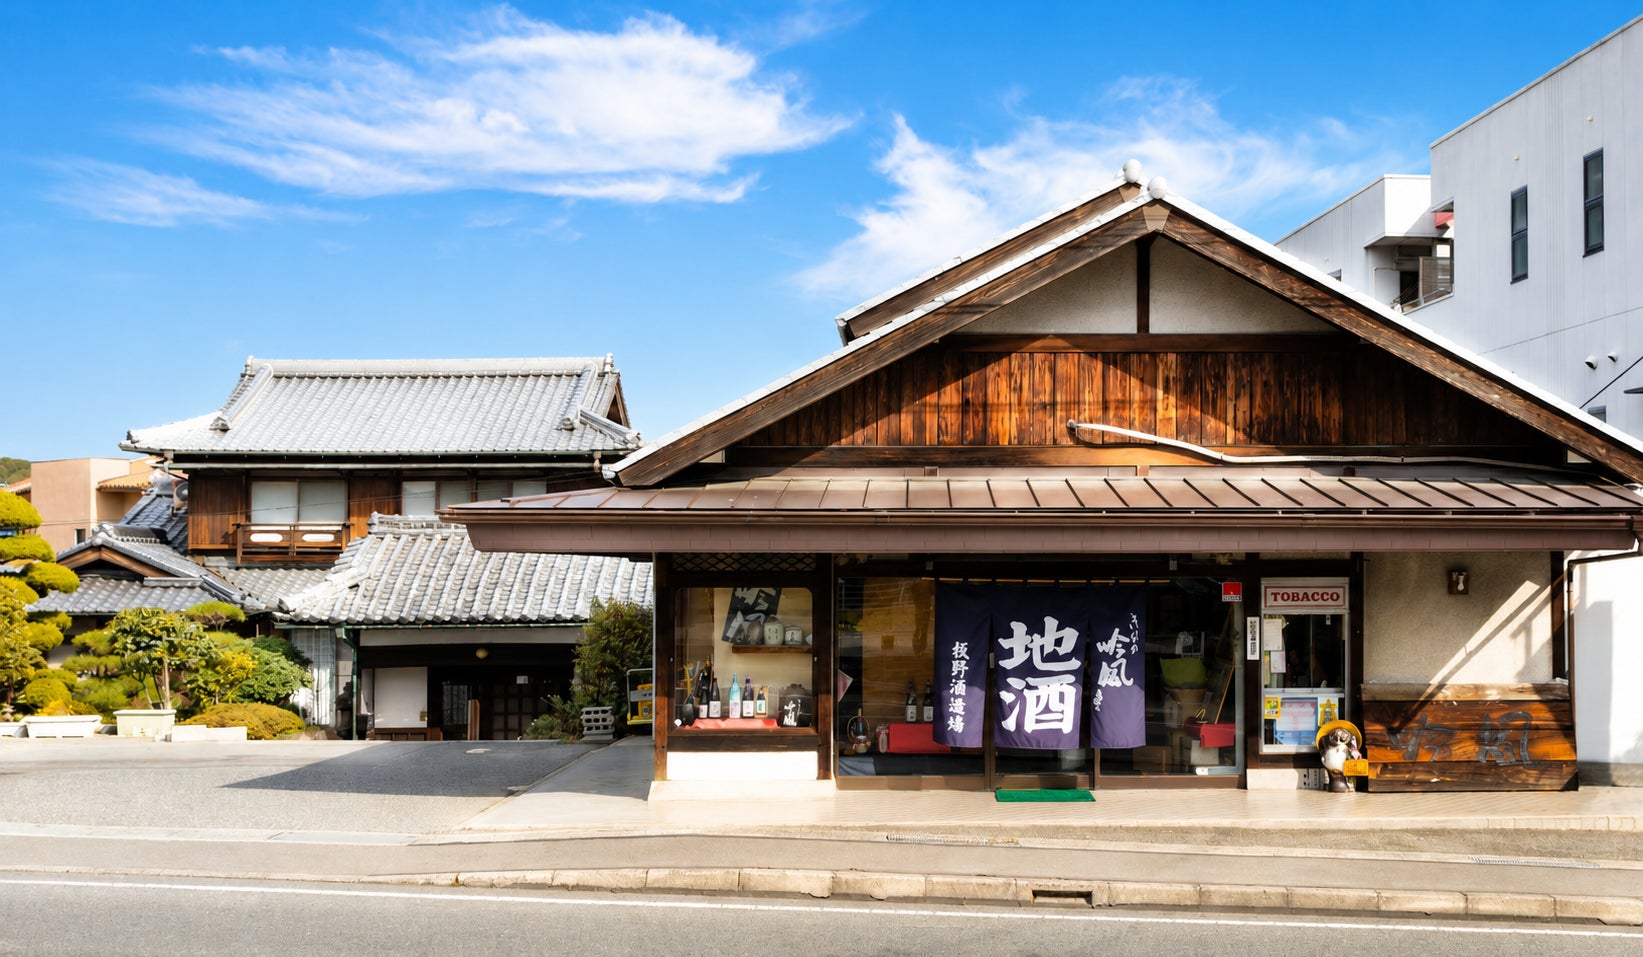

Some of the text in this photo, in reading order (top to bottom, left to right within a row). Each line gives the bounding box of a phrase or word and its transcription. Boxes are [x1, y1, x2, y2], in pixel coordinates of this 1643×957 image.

[1270, 591, 1341, 602] TOBACCO
[947, 641, 970, 733] 板野酒造場
[997, 615, 1082, 735] 地酒
